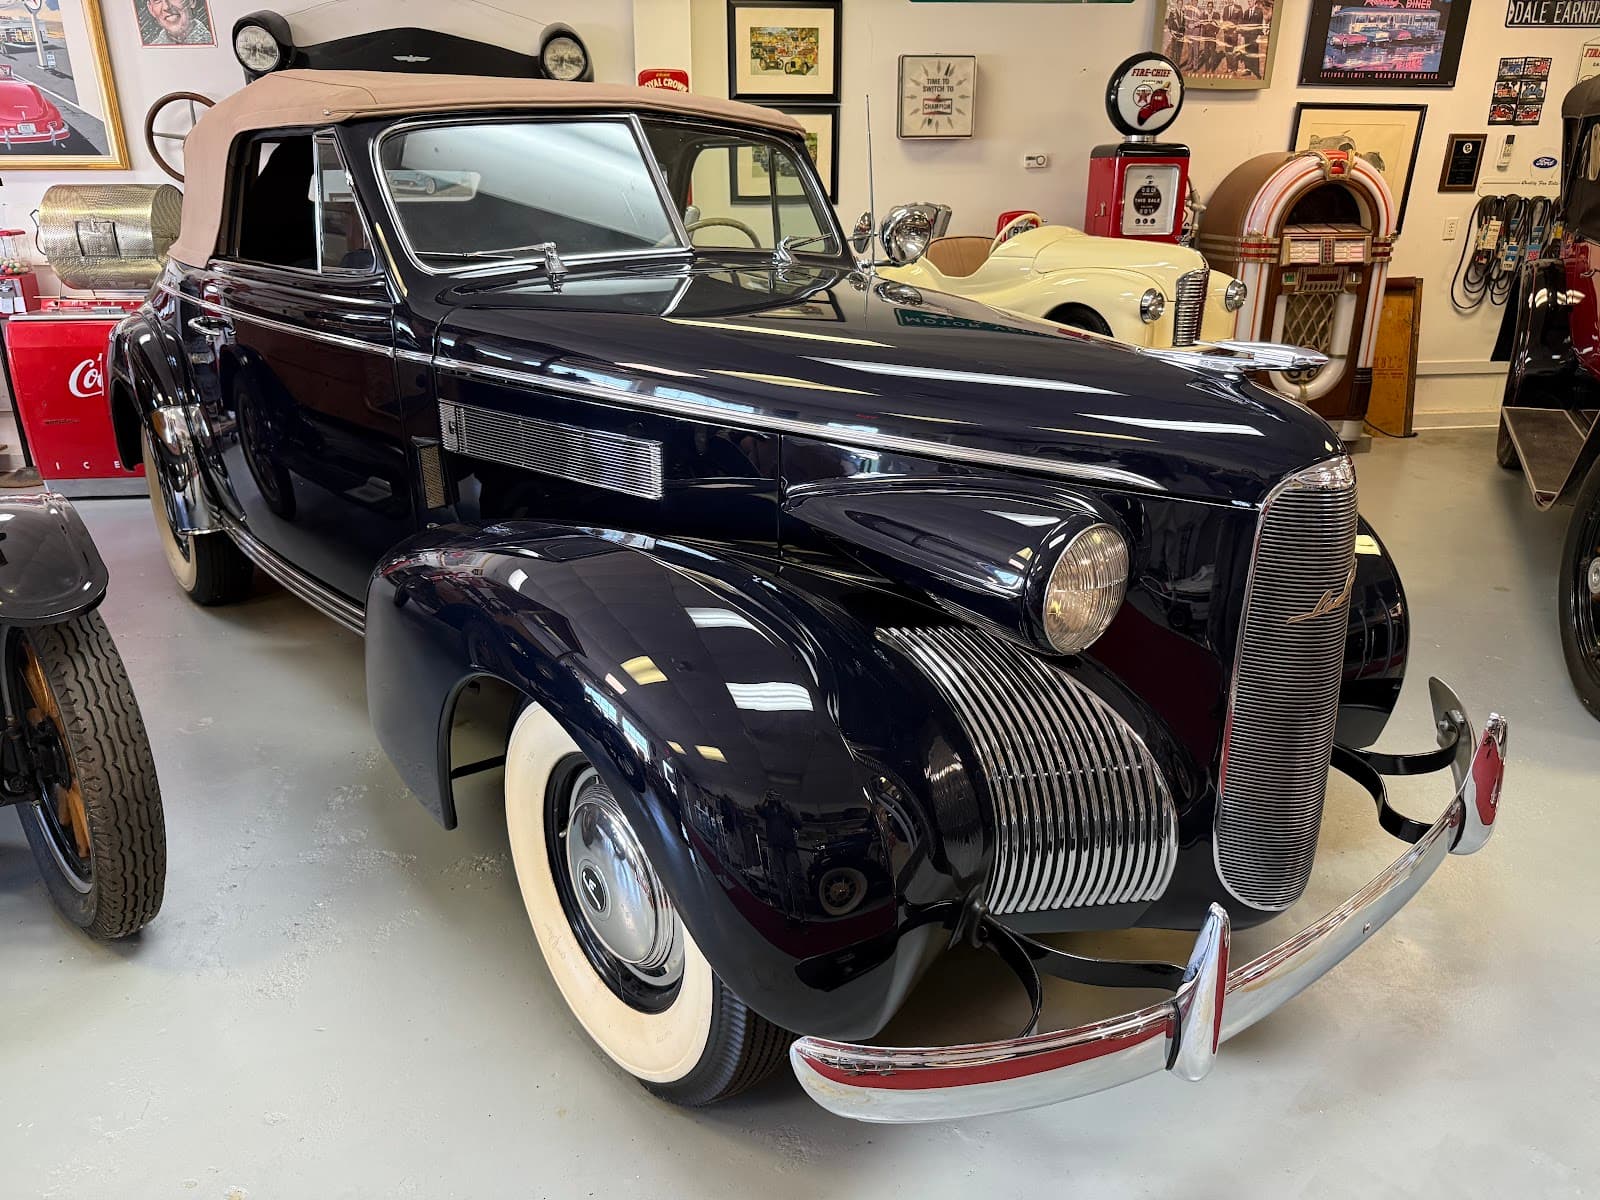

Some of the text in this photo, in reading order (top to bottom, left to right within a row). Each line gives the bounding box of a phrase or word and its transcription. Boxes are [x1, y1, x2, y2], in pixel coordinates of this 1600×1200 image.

[1513, 1, 1550, 24] DALE
[1131, 68, 1172, 78] FIRE-CHIEF
[642, 78, 663, 89] OYAL
[922, 85, 955, 93] SWITCH TO
[1535, 158, 1556, 167] Ford
[55, 460, 121, 471] ICE
